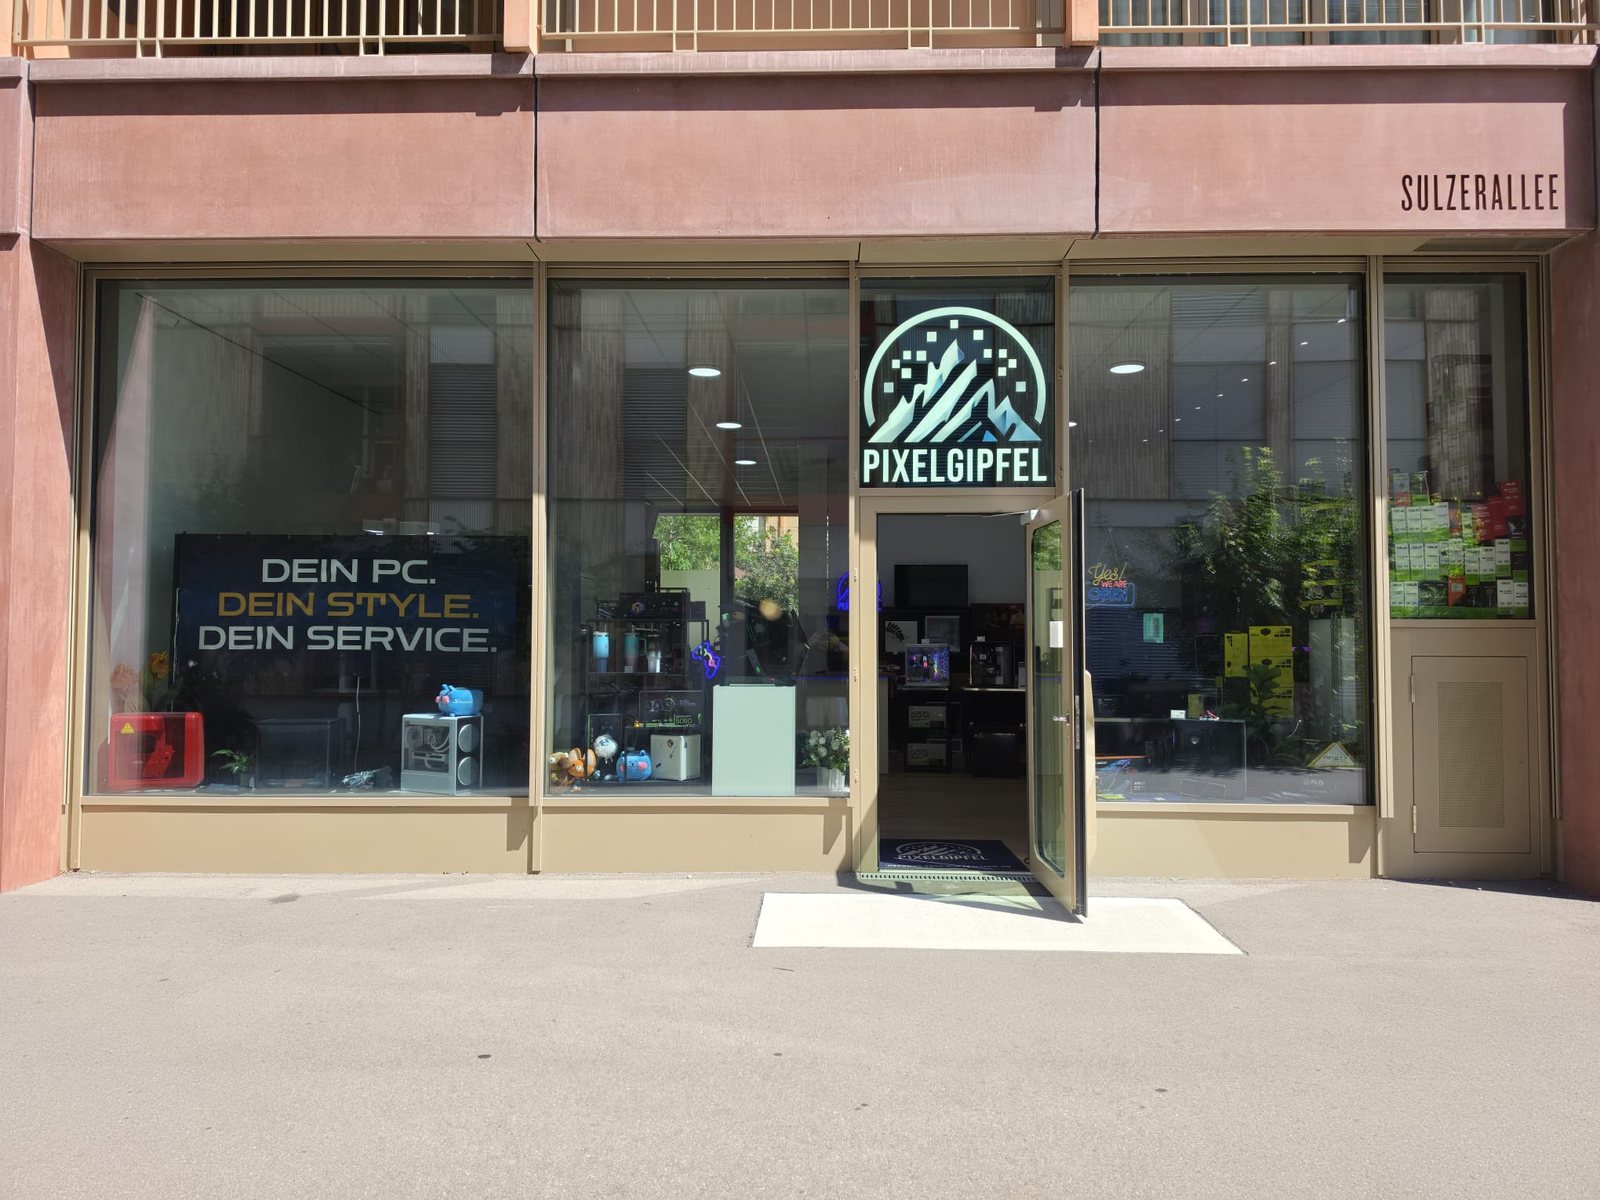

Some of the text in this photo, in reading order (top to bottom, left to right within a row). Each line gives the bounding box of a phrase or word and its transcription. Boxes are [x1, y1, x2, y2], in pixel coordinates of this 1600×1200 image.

[1401, 174, 1559, 211] SULZERALLEE
[863, 447, 1047, 483] PIXELGIPFEL
[261, 558, 436, 585] DEIN PC.
[1088, 562, 1128, 586] Yes!
[1101, 580, 1128, 588] WE ARE
[218, 591, 479, 619] DEIN STYLE.
[1088, 587, 1128, 601] OPEN
[198, 625, 497, 653] DEIN SERVICE.
